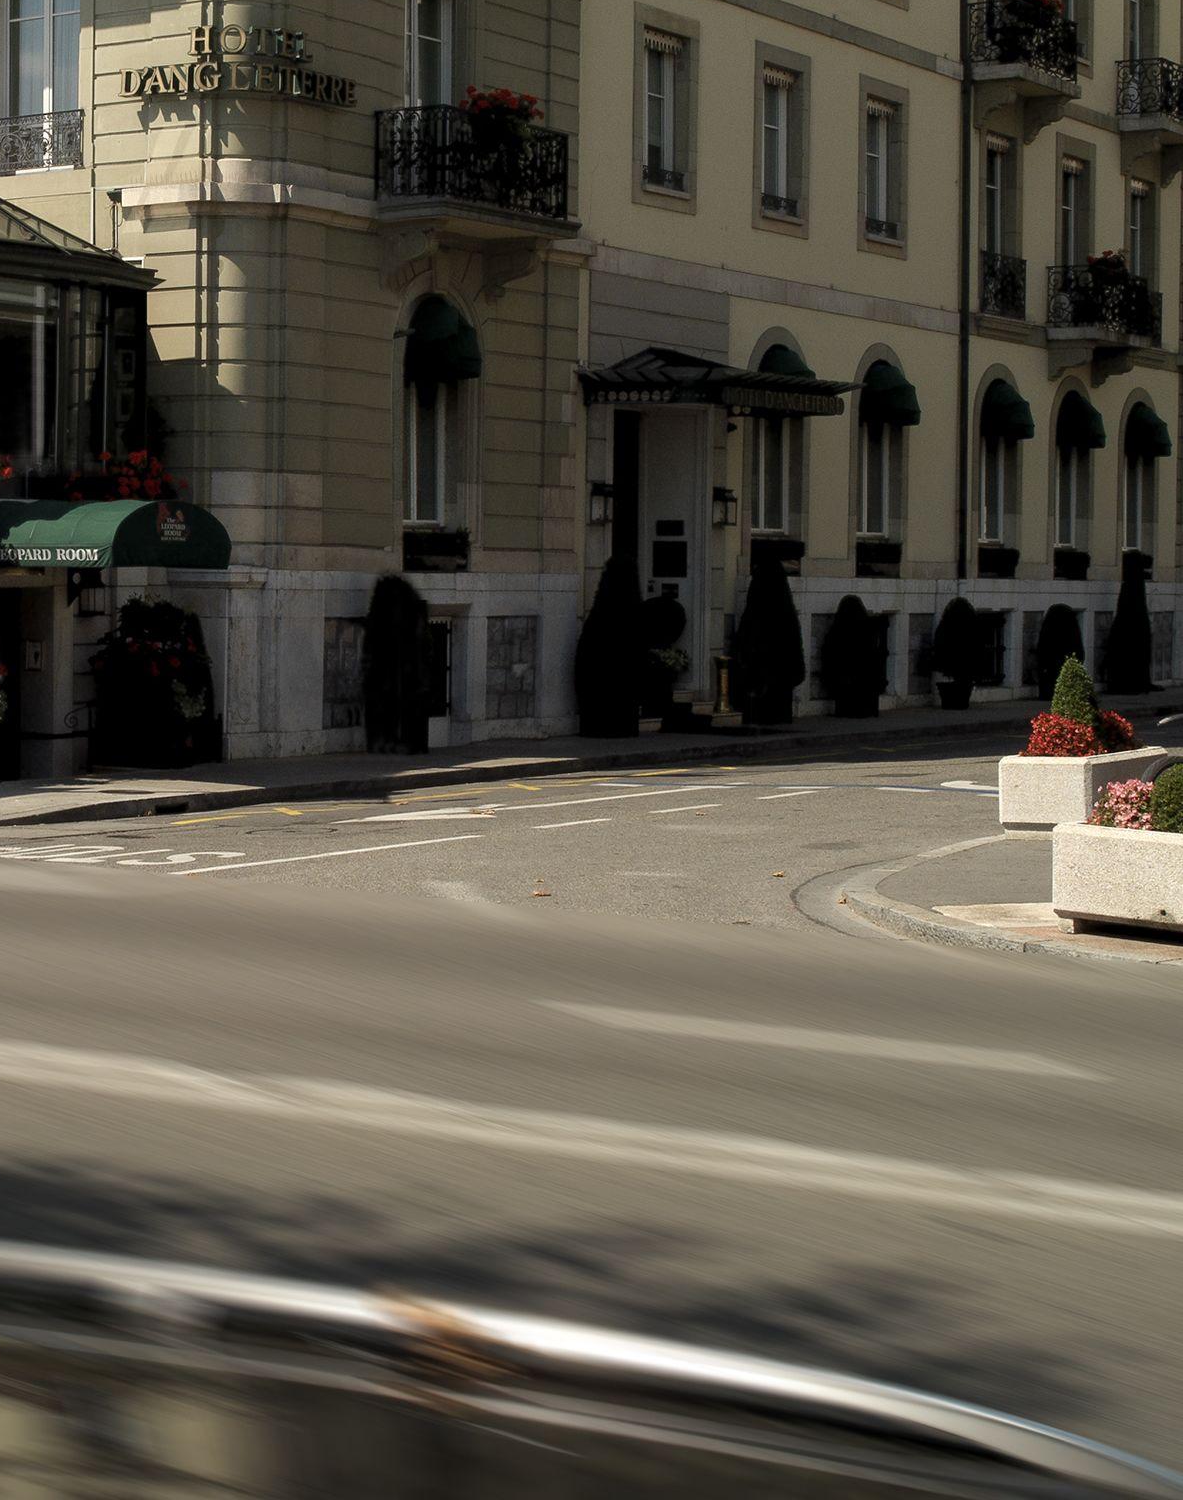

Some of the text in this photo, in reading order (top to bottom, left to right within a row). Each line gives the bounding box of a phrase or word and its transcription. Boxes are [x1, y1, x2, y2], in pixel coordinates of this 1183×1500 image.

[187, 24, 313, 59] HOTEL
[118, 59, 358, 108] D'ANGLETERRE
[56, 548, 99, 561] ROOM
